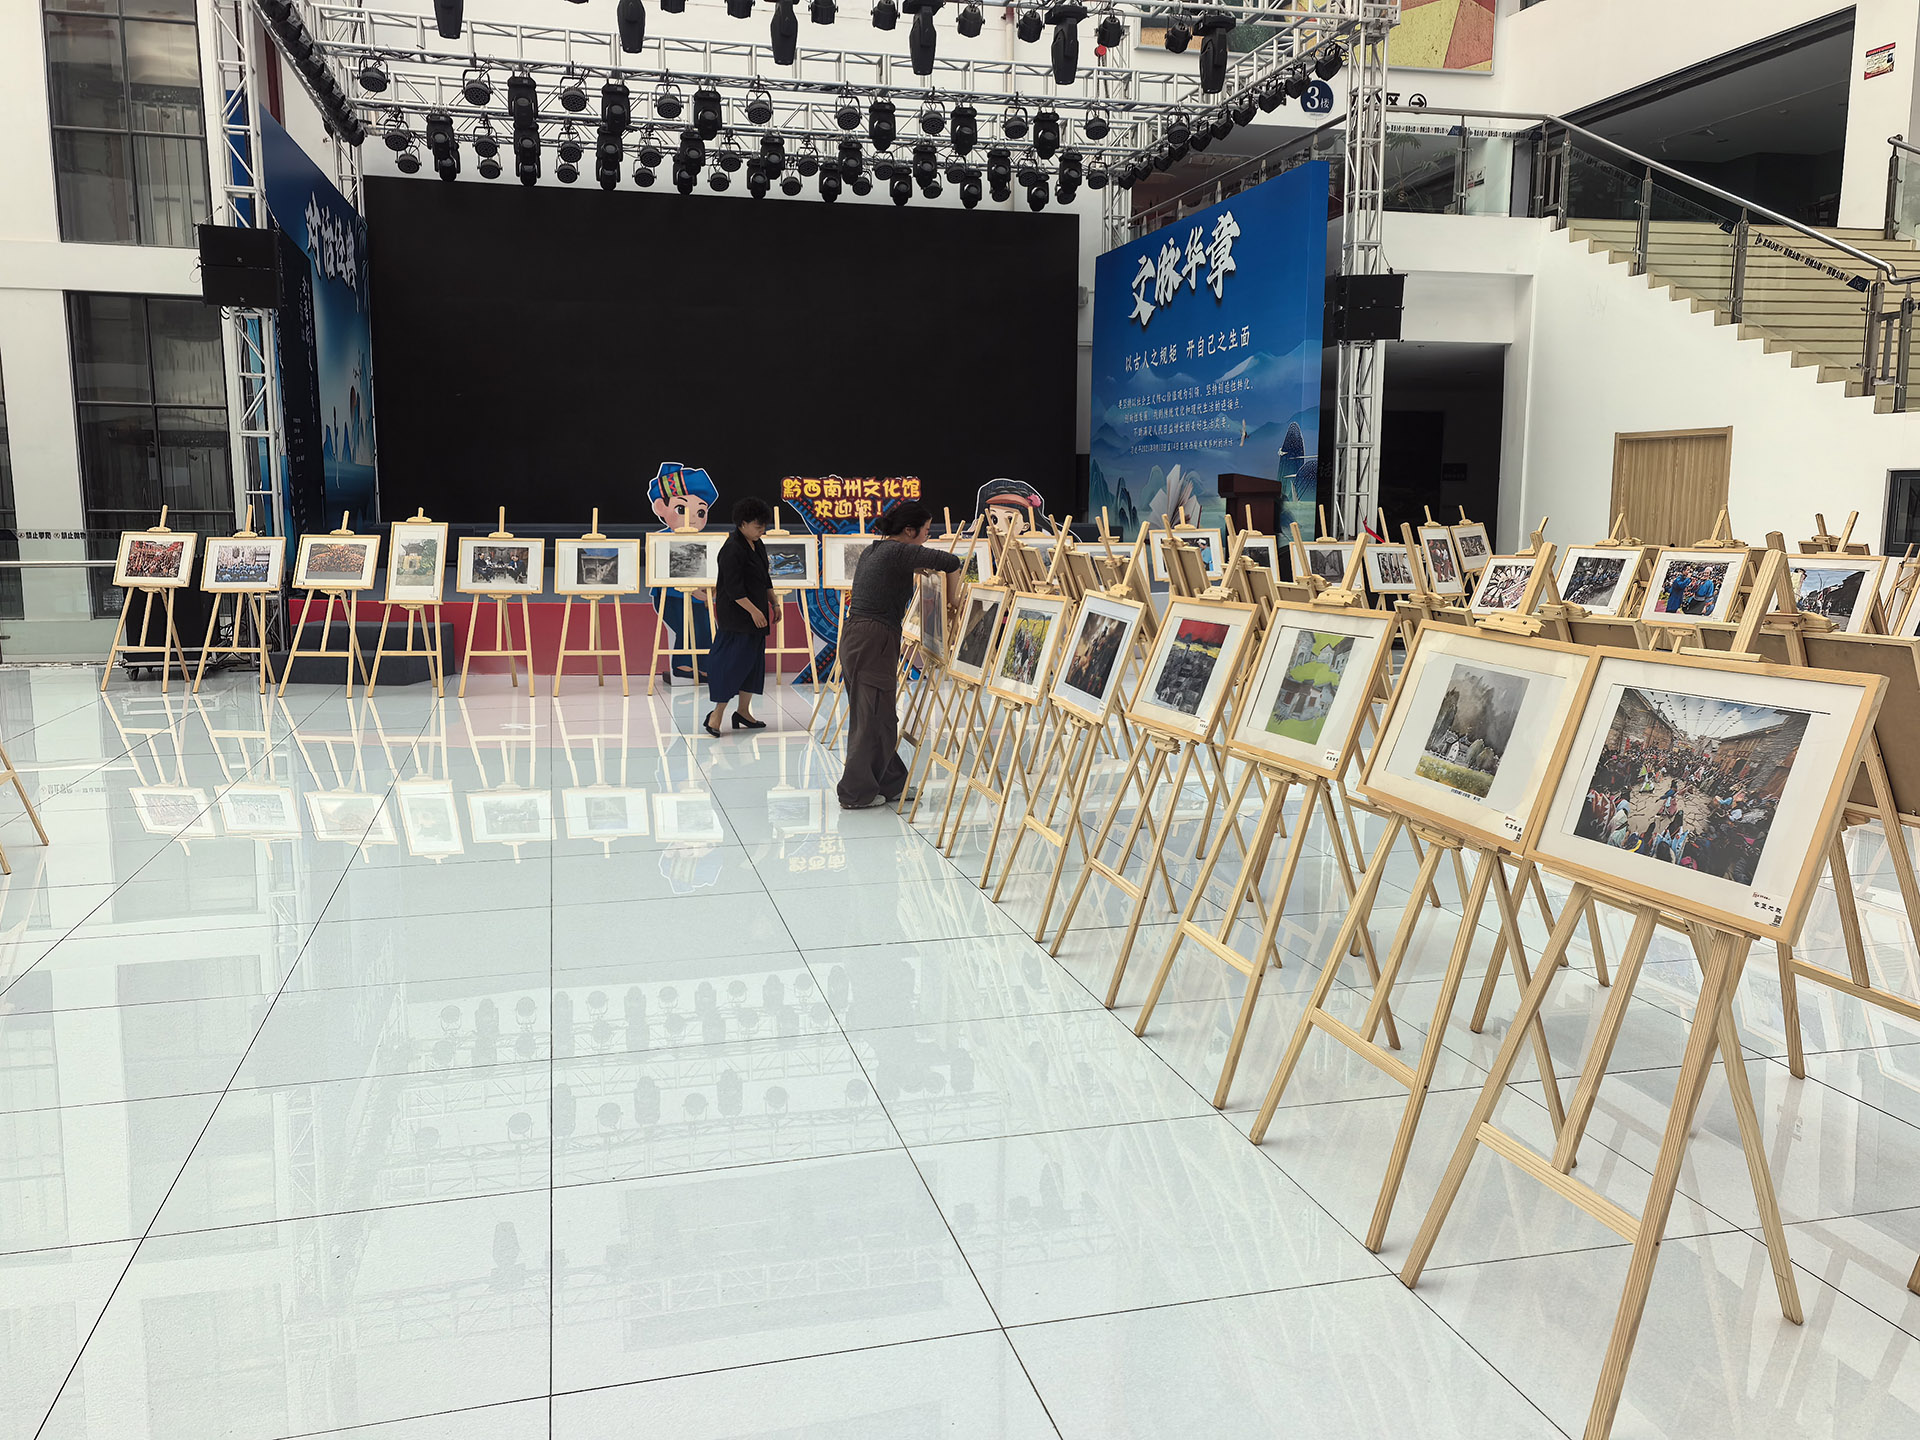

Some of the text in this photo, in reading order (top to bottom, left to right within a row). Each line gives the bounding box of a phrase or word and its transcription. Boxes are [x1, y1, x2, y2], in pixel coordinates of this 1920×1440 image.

[1128, 211, 1240, 326] 文脉华章
[1125, 325, 1250, 372] 以古人之规矩 开自己之生面
[783, 478, 920, 498] 黔西南州文化馆
